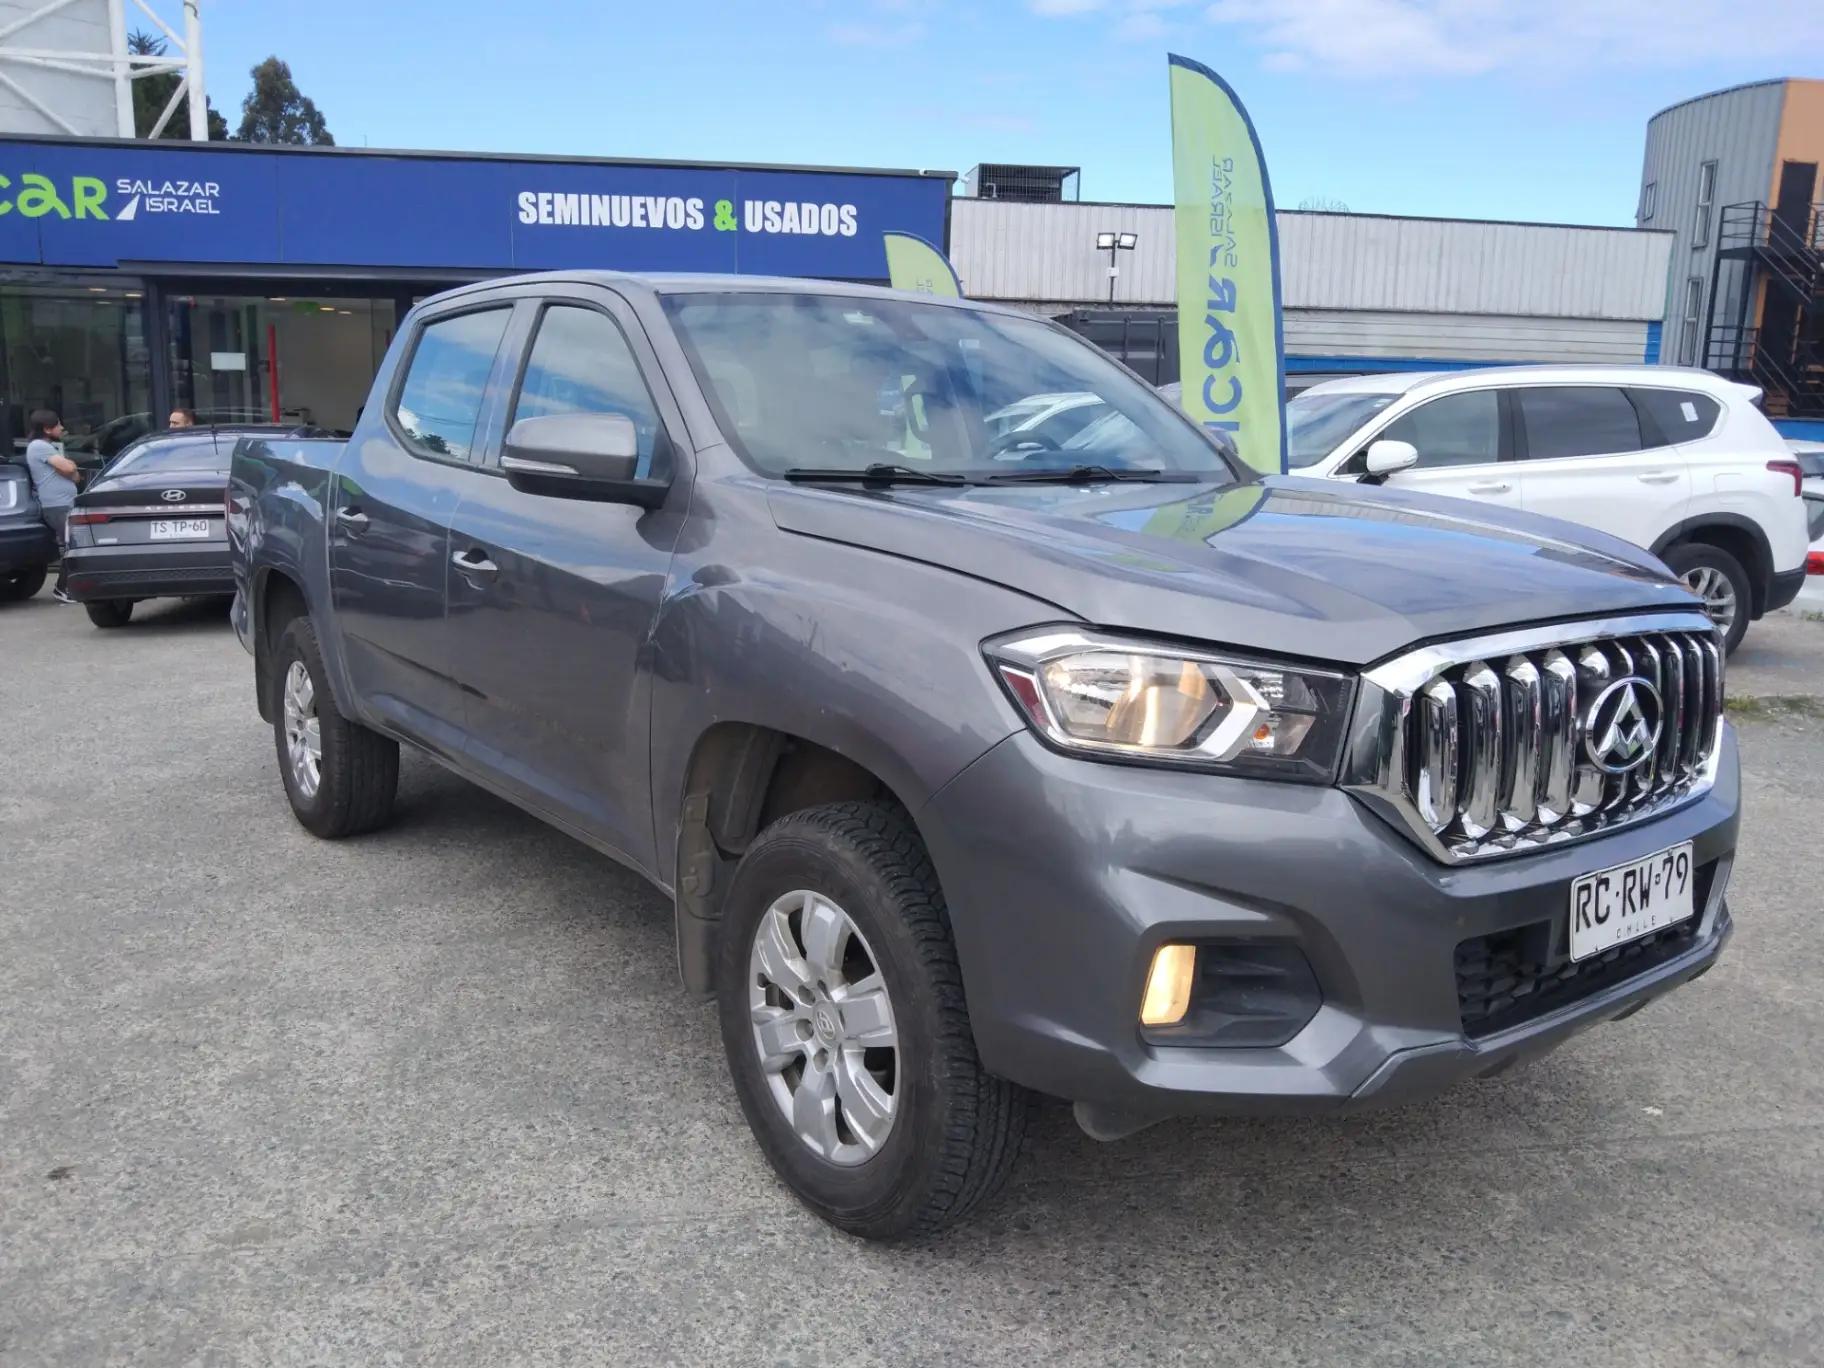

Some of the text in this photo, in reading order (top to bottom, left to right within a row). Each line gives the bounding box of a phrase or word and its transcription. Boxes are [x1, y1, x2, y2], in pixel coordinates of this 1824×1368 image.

[116, 179, 220, 197] SALAZAR
[145, 198, 220, 214] ISRAEL
[518, 191, 858, 236] SEMINUEVOS & USADOS
[1616, 915, 1656, 939] CHILE
